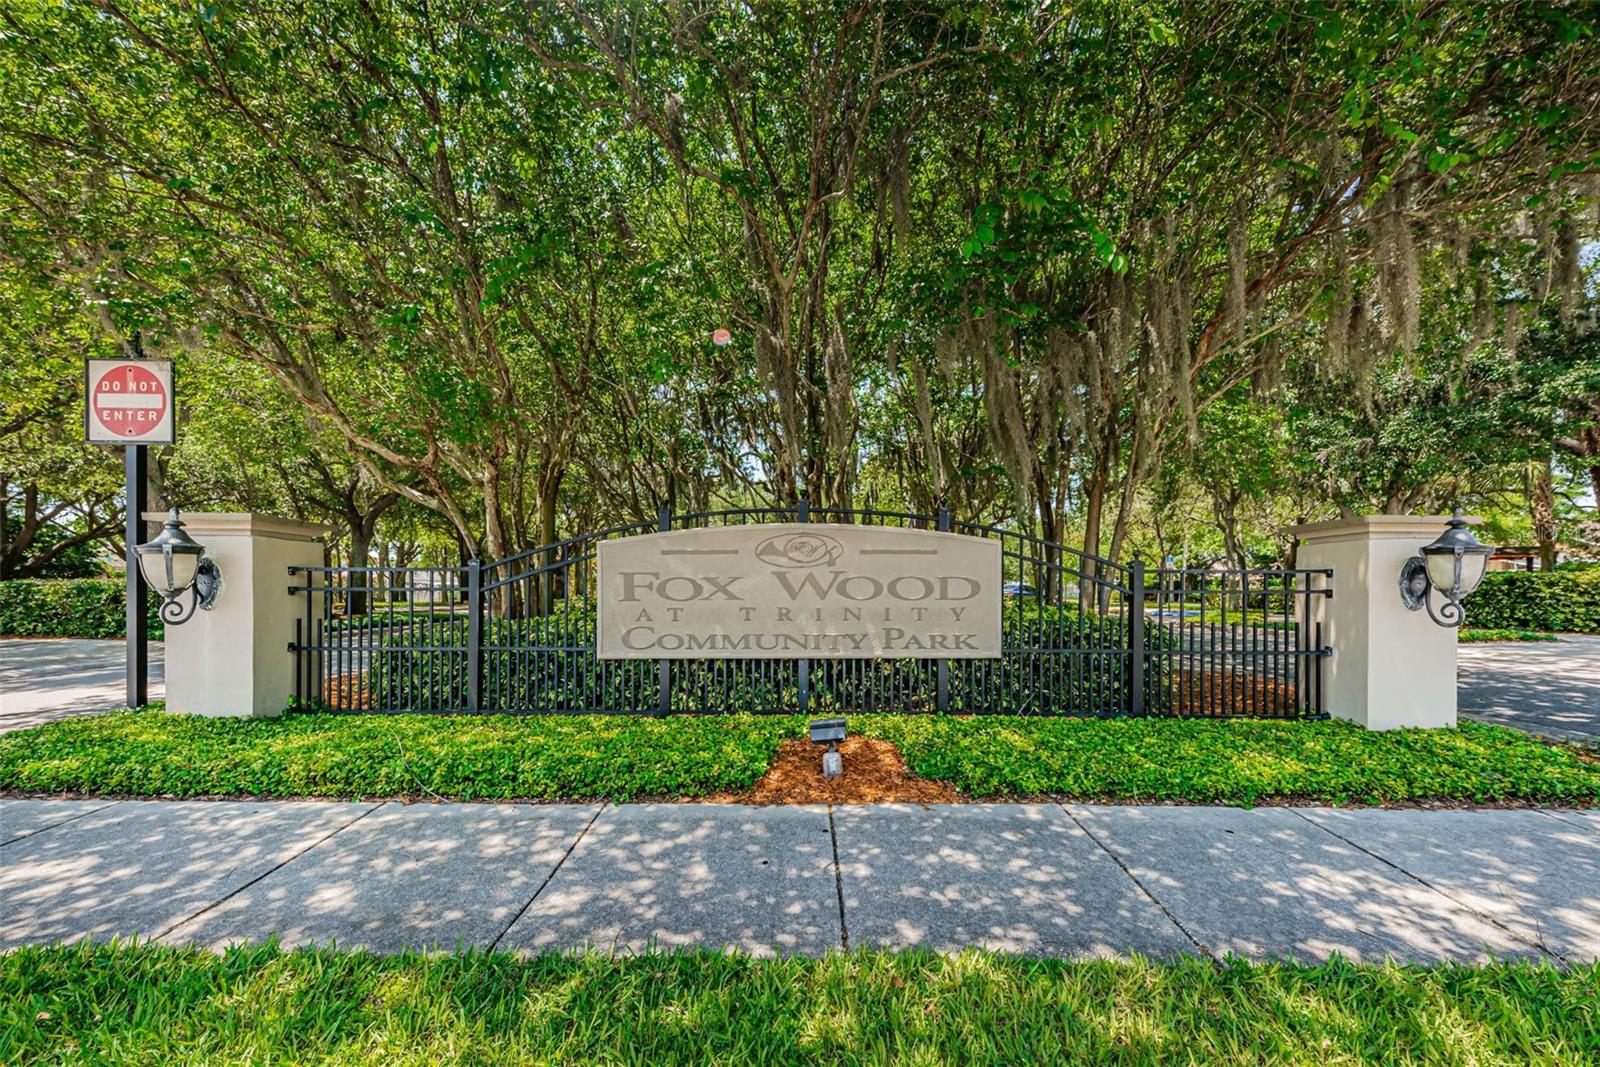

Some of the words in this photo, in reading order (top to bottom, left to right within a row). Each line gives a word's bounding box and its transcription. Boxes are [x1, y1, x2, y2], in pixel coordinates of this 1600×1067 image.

[102, 381, 120, 391] DO
[129, 381, 157, 392] NOT
[103, 410, 157, 421] ENTER
[635, 607, 684, 622] AT
[739, 606, 967, 622] TRINITY
[622, 626, 869, 650] COMMUNITY
[881, 627, 980, 650] PARK
